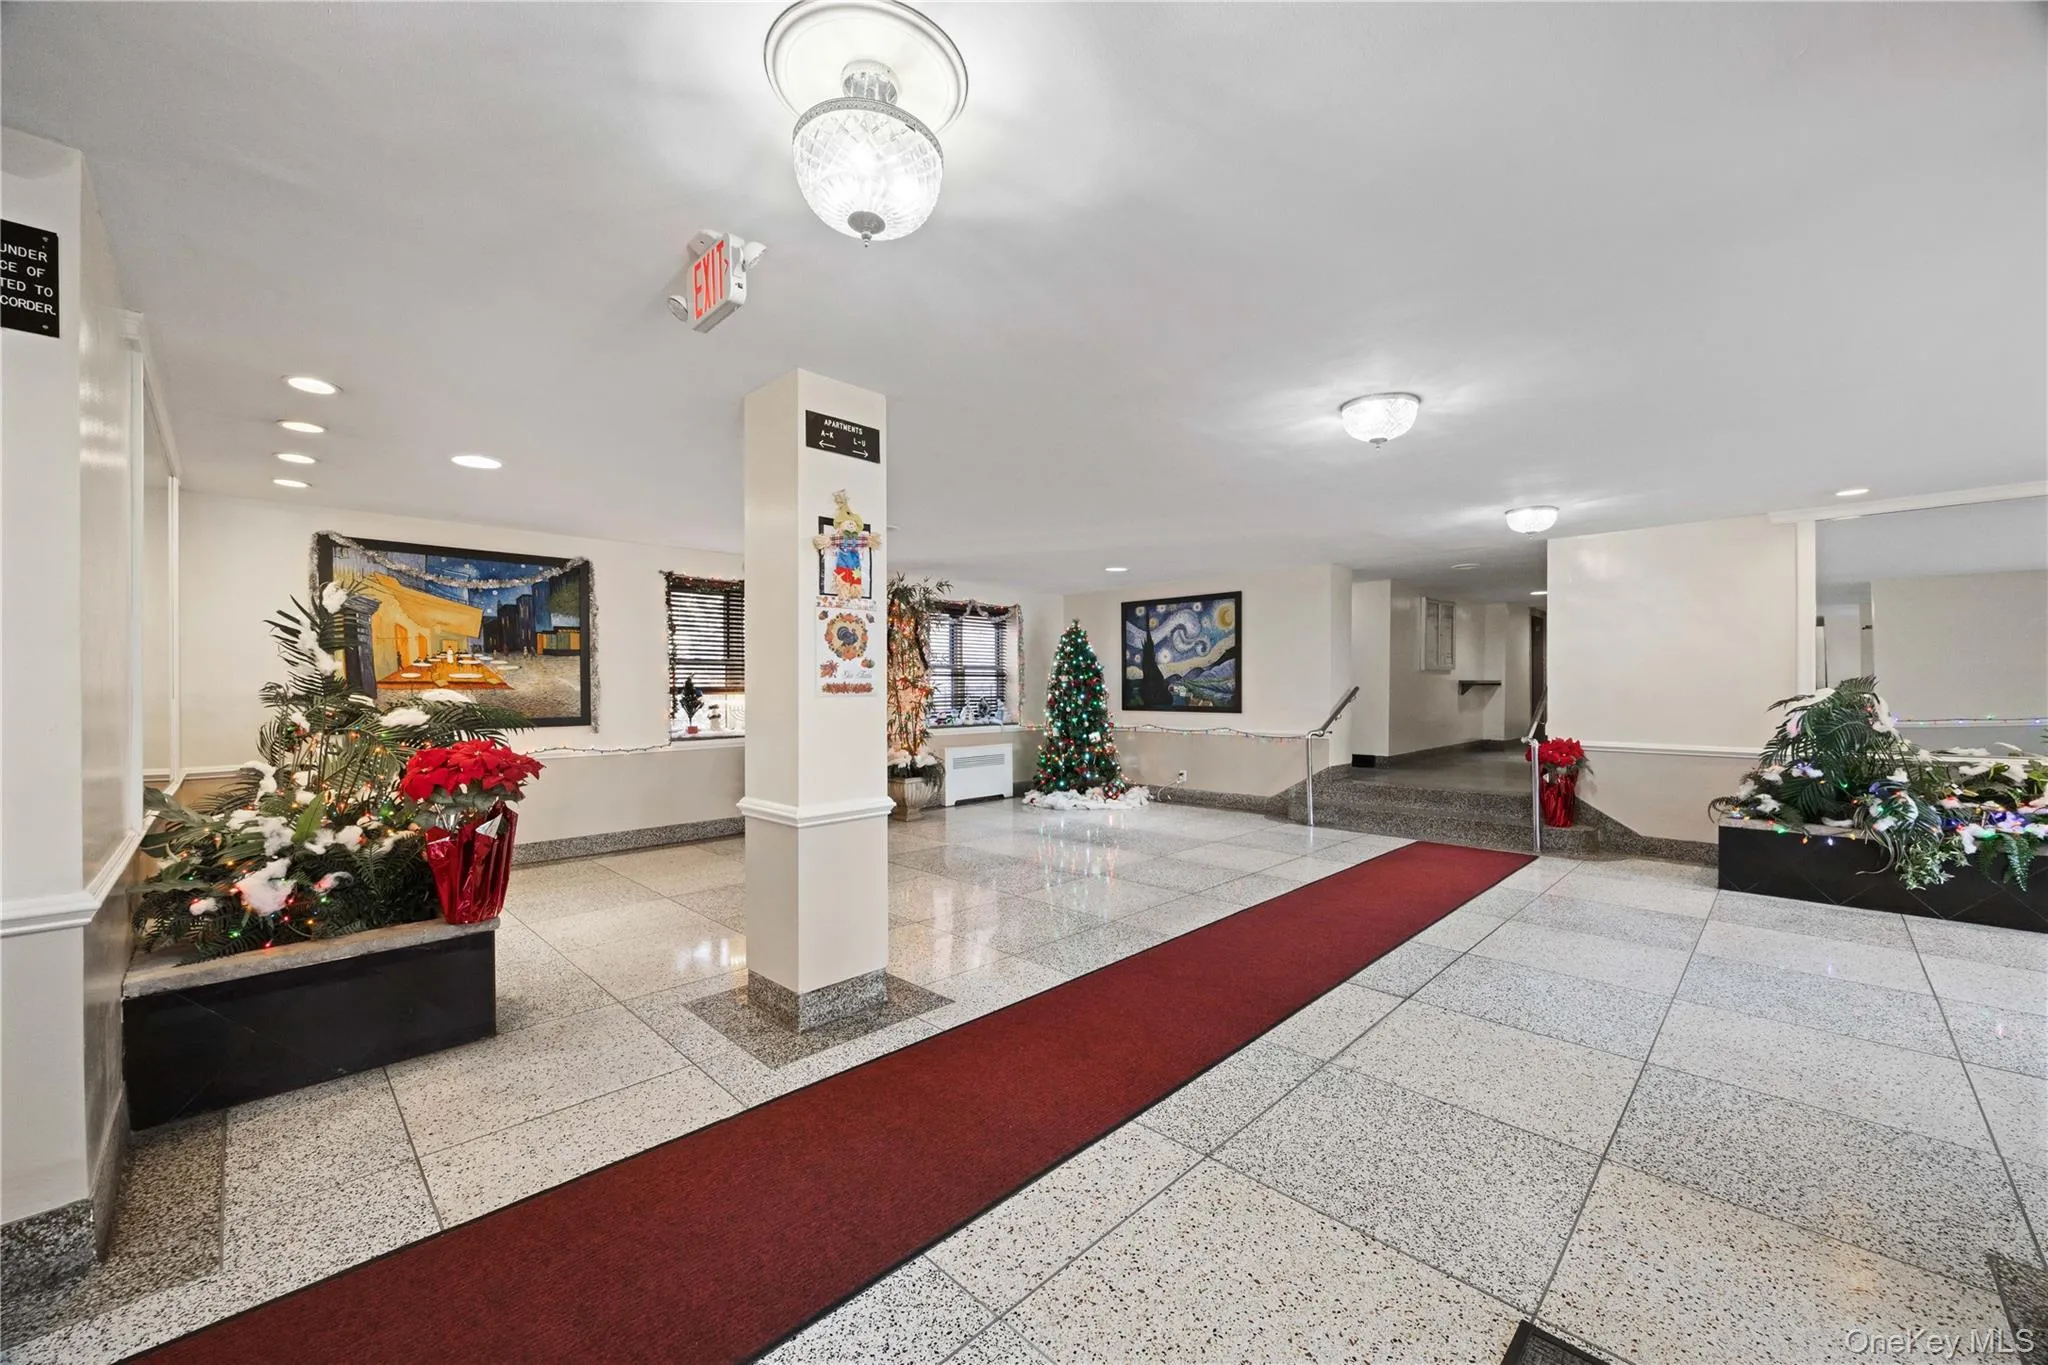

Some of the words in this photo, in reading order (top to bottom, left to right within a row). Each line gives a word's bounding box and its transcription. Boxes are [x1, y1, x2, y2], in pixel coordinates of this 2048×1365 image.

[26, 265, 46, 278] OF
[693, 240, 724, 320] EXIT
[34, 284, 53, 298] TO
[823, 419, 863, 435] APARTMENTS
[853, 437, 866, 447] L-U
